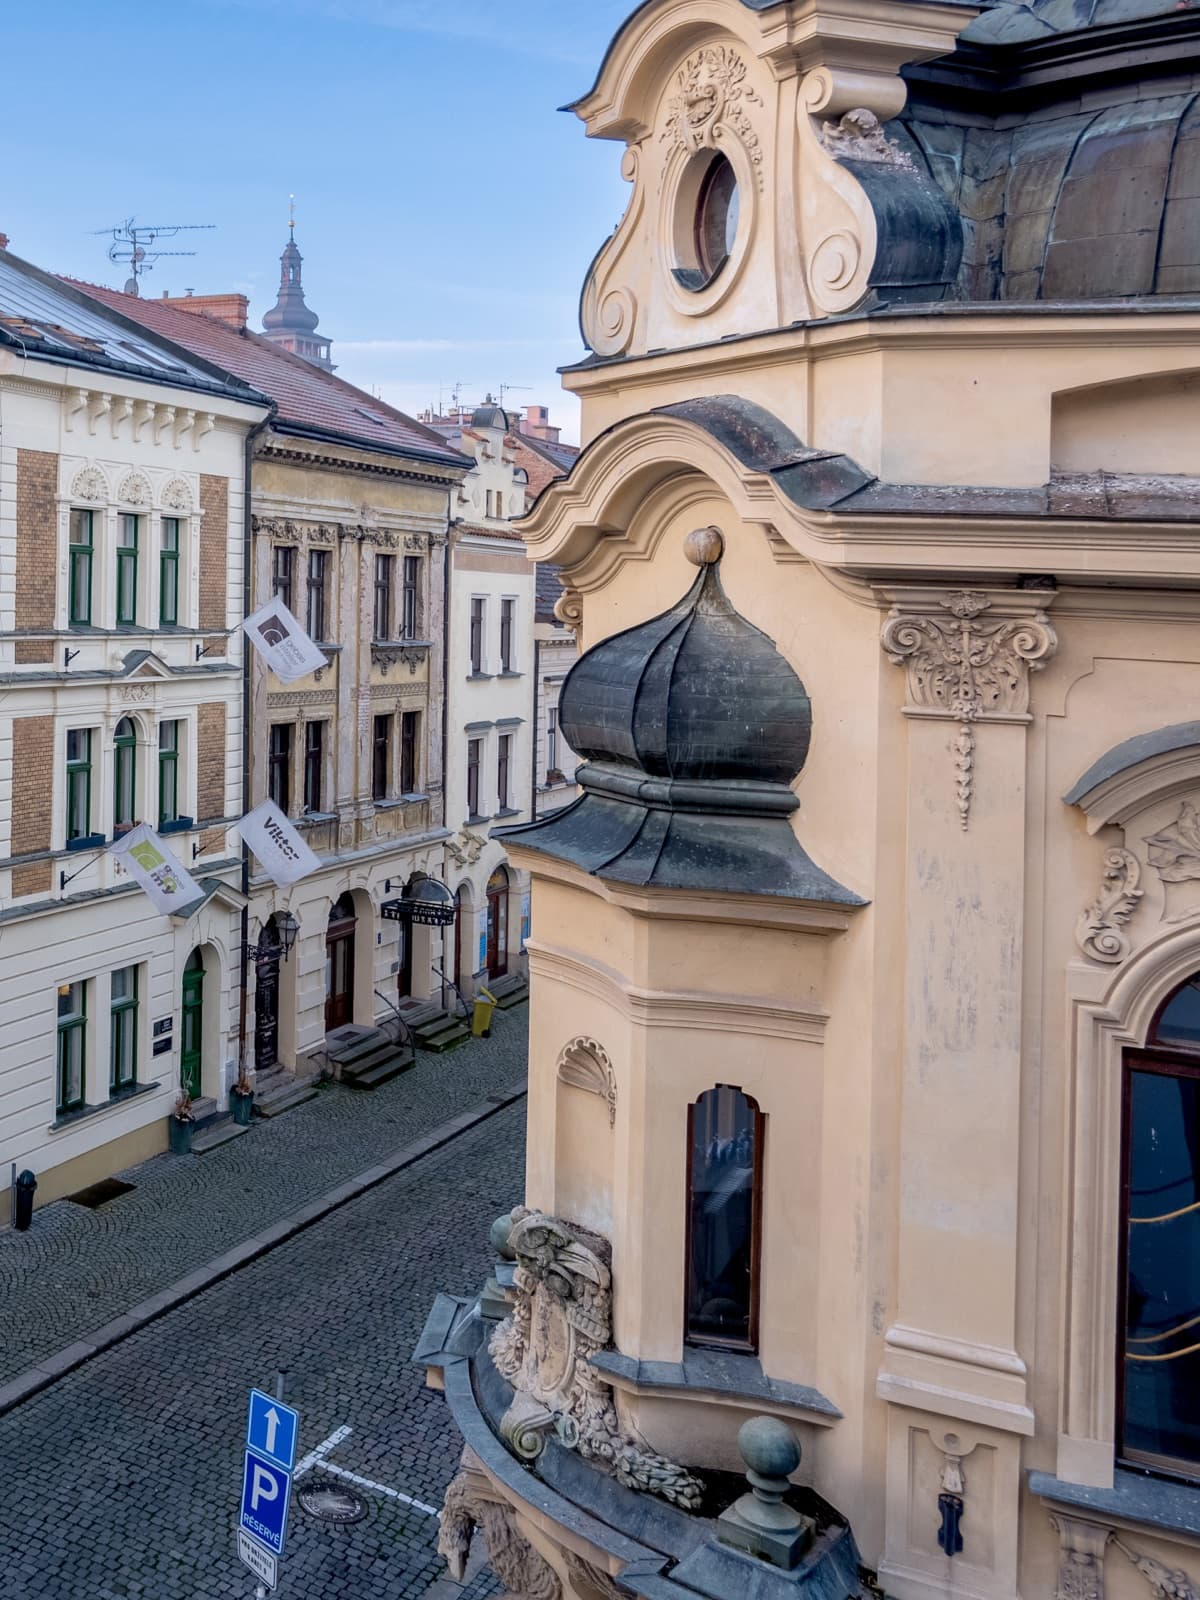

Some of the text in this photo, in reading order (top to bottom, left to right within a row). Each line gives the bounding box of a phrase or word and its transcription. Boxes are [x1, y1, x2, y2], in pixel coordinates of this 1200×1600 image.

[264, 815, 300, 860] Viktor
[251, 1463, 279, 1511] P
[243, 1512, 280, 1546] RÉSERVÉ
